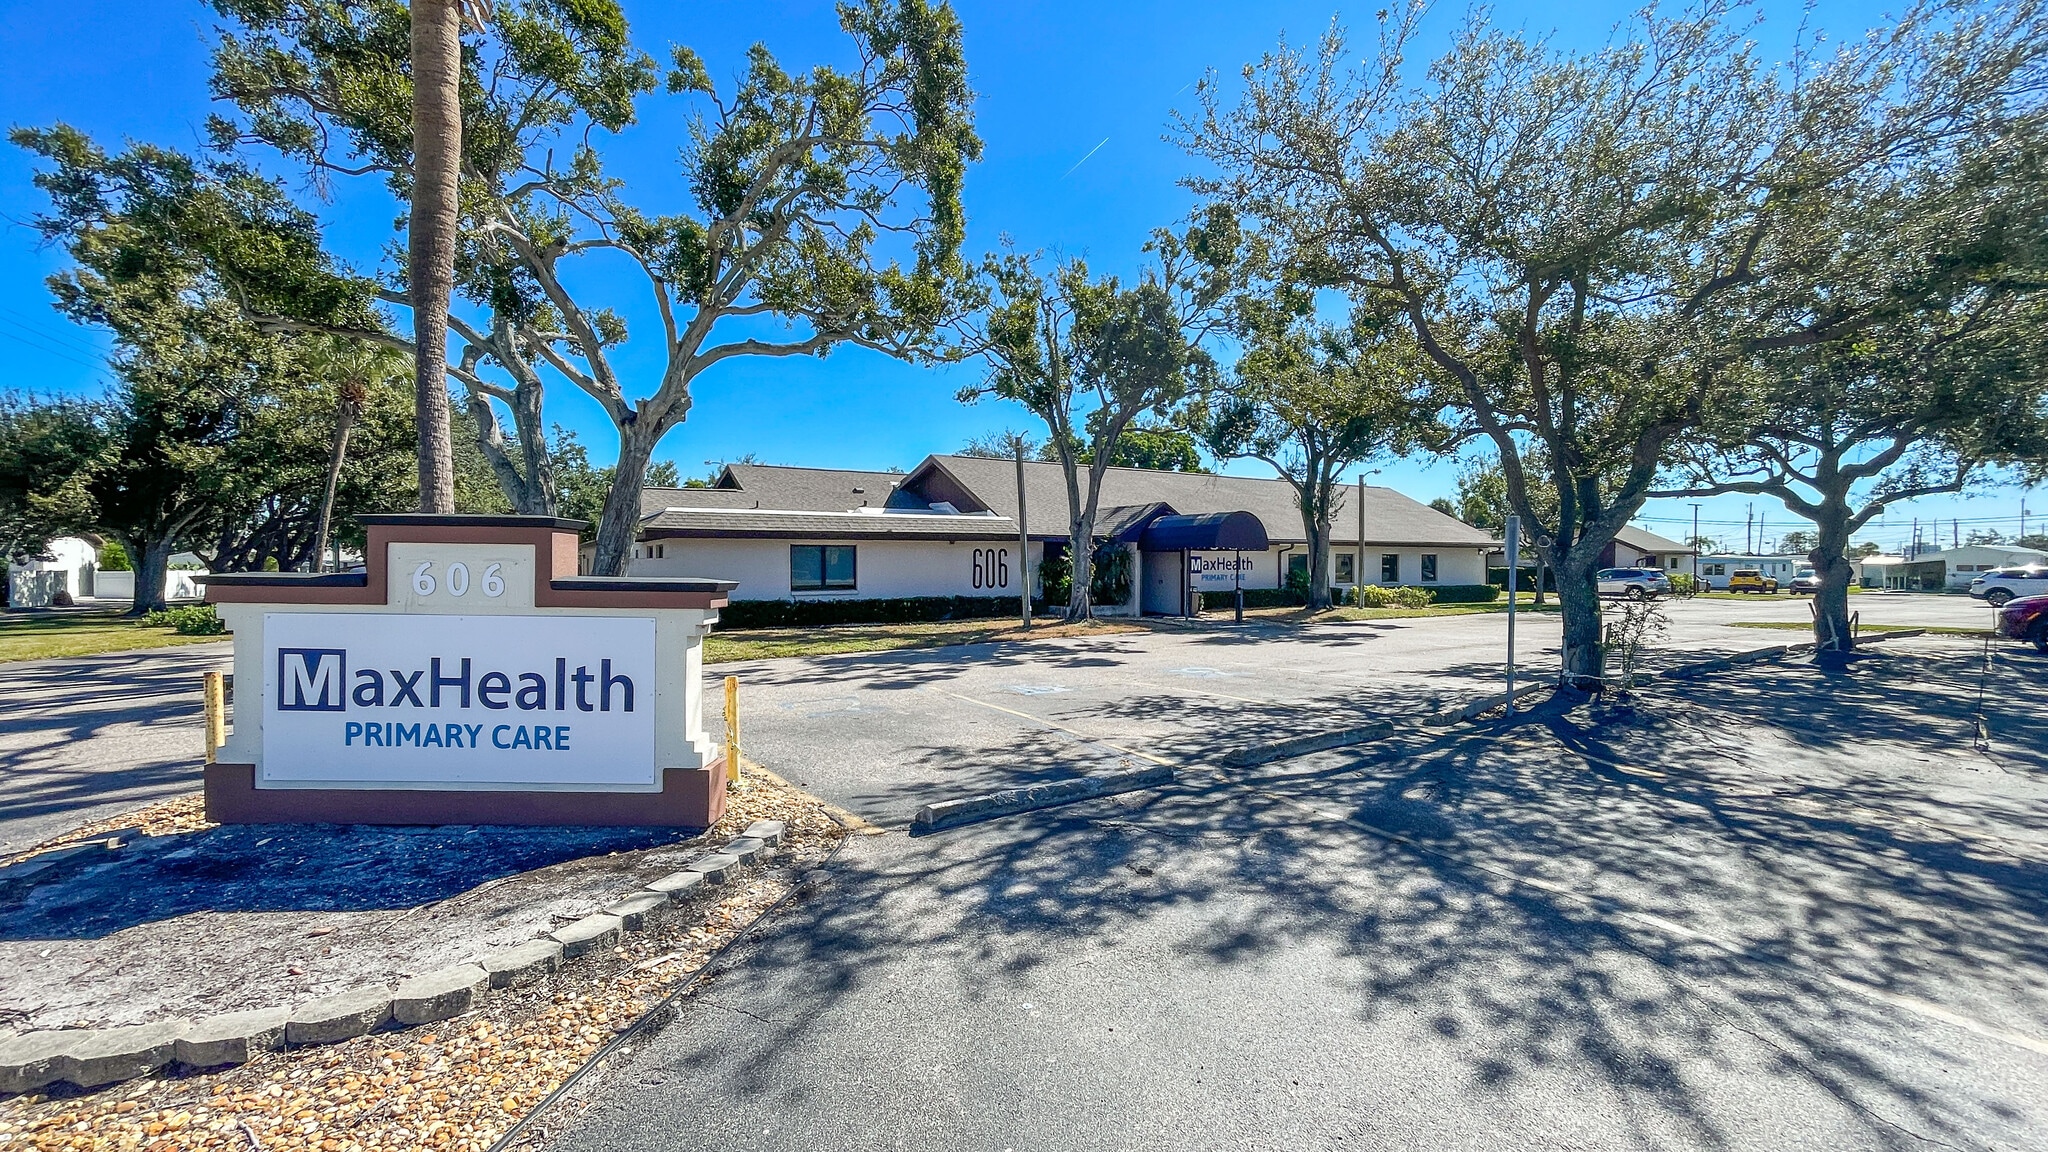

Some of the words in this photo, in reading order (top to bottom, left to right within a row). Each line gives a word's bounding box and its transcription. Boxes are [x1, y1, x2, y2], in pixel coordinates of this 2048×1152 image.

[412, 561, 506, 598] 606
[972, 548, 1008, 589] 606
[1190, 556, 1253, 573] MaxHealth
[1201, 573, 1228, 581] PRIMARY
[278, 648, 634, 712] MaxHealth
[345, 721, 483, 750] PRIMARY
[492, 724, 571, 751] CARE
